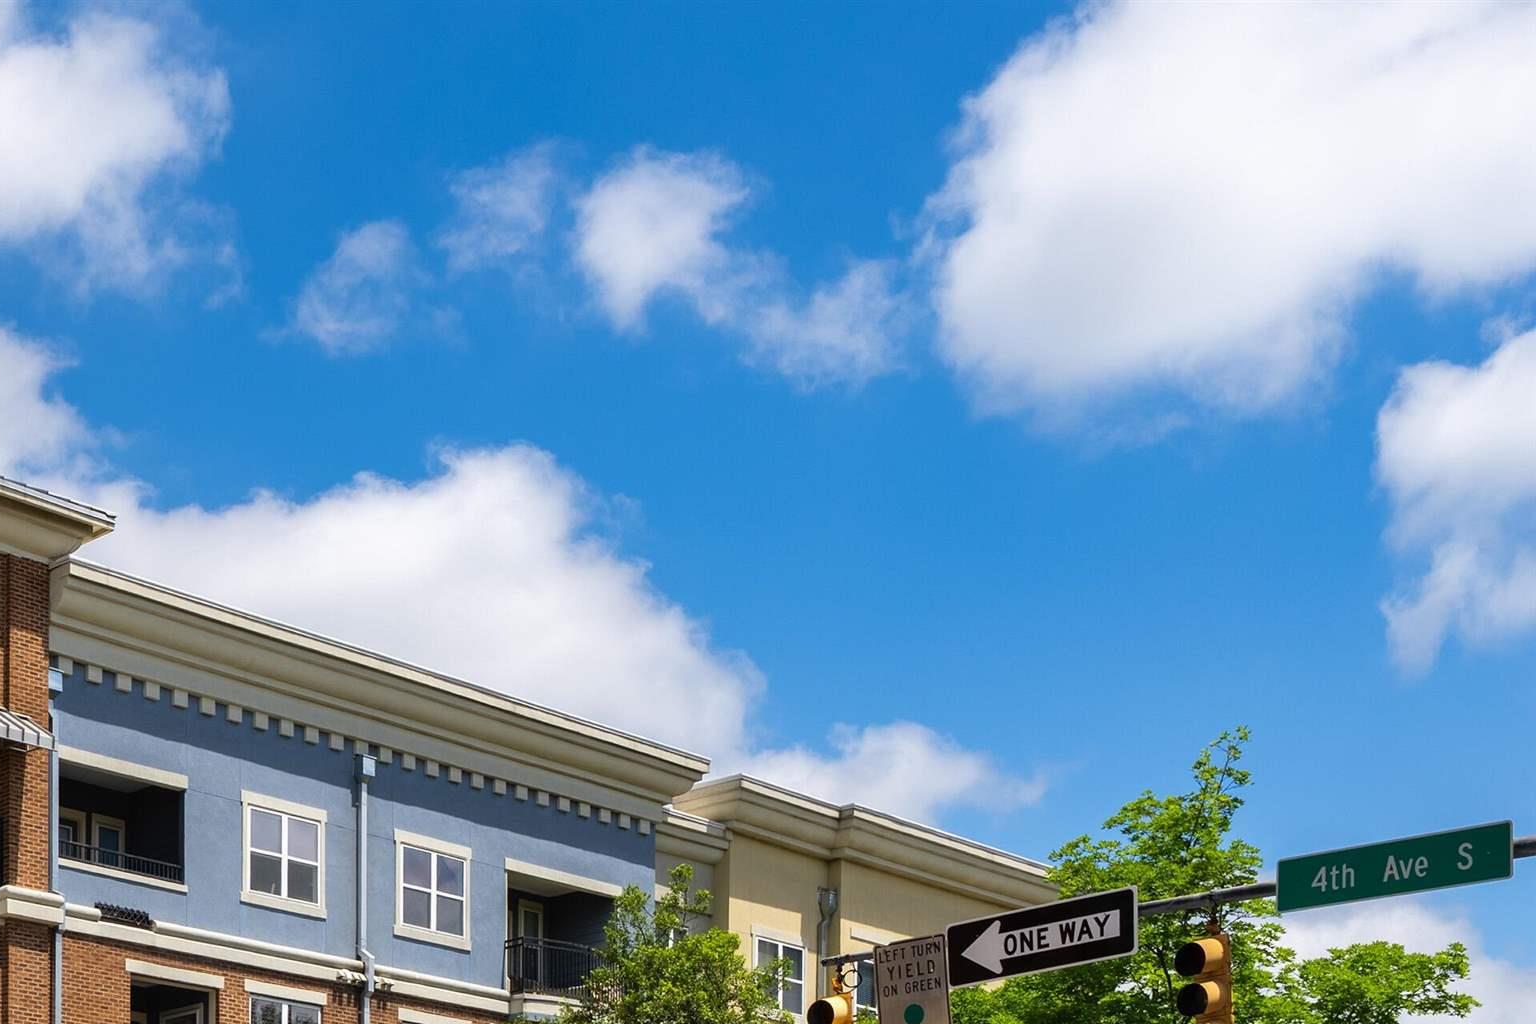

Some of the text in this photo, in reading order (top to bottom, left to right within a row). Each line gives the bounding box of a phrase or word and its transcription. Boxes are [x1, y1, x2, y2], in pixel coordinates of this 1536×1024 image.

[1311, 842, 1473, 892] 4th Ave S
[1003, 913, 1111, 956] ONE WAY
[878, 941, 941, 964] LEFT TURN
[887, 960, 936, 981] YIELD
[883, 977, 942, 998] ON GREEN
